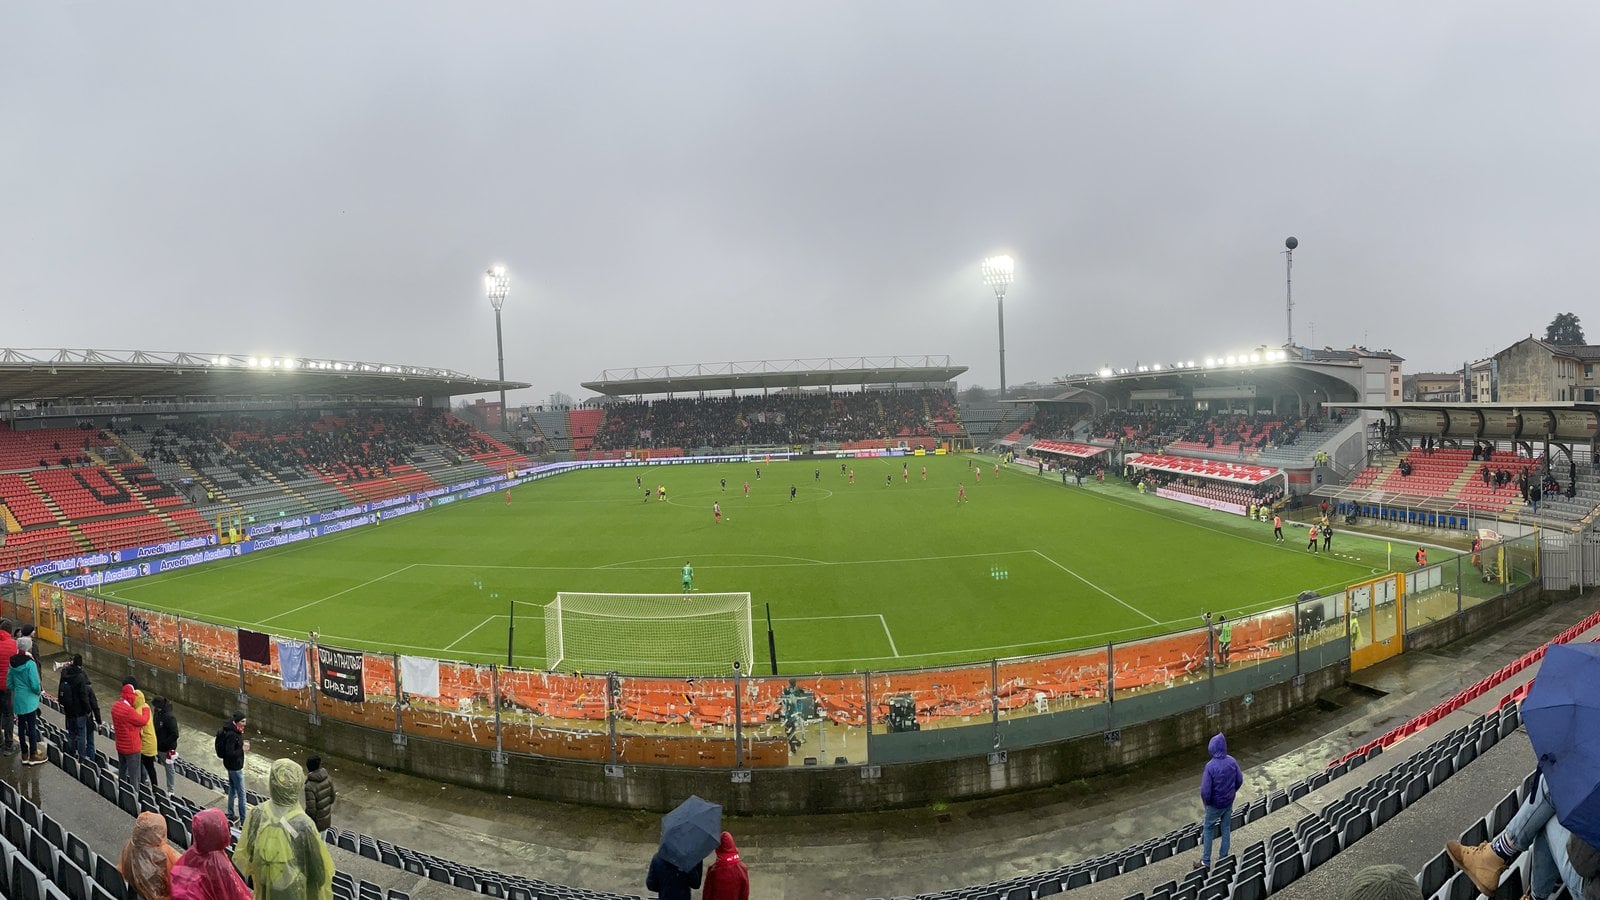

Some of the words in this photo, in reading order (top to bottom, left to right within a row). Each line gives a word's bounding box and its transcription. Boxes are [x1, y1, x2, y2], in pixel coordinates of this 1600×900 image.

[251, 524, 273, 536] Arvedi
[138, 543, 166, 558] Arvedi
[165, 541, 180, 552] Tubi
[181, 537, 206, 549] Acciaio
[254, 538, 276, 550] Arvedi
[31, 562, 57, 576] Arvedi
[57, 558, 76, 570] Tubi
[77, 554, 108, 567] Acciaio
[161, 557, 189, 571] Arvedi
[189, 553, 204, 564] Tubi
[204, 548, 231, 561] Acciaio
[53, 575, 82, 590] Arvedi
[85, 573, 103, 585] Tubi
[105, 566, 137, 582] Acciaio
